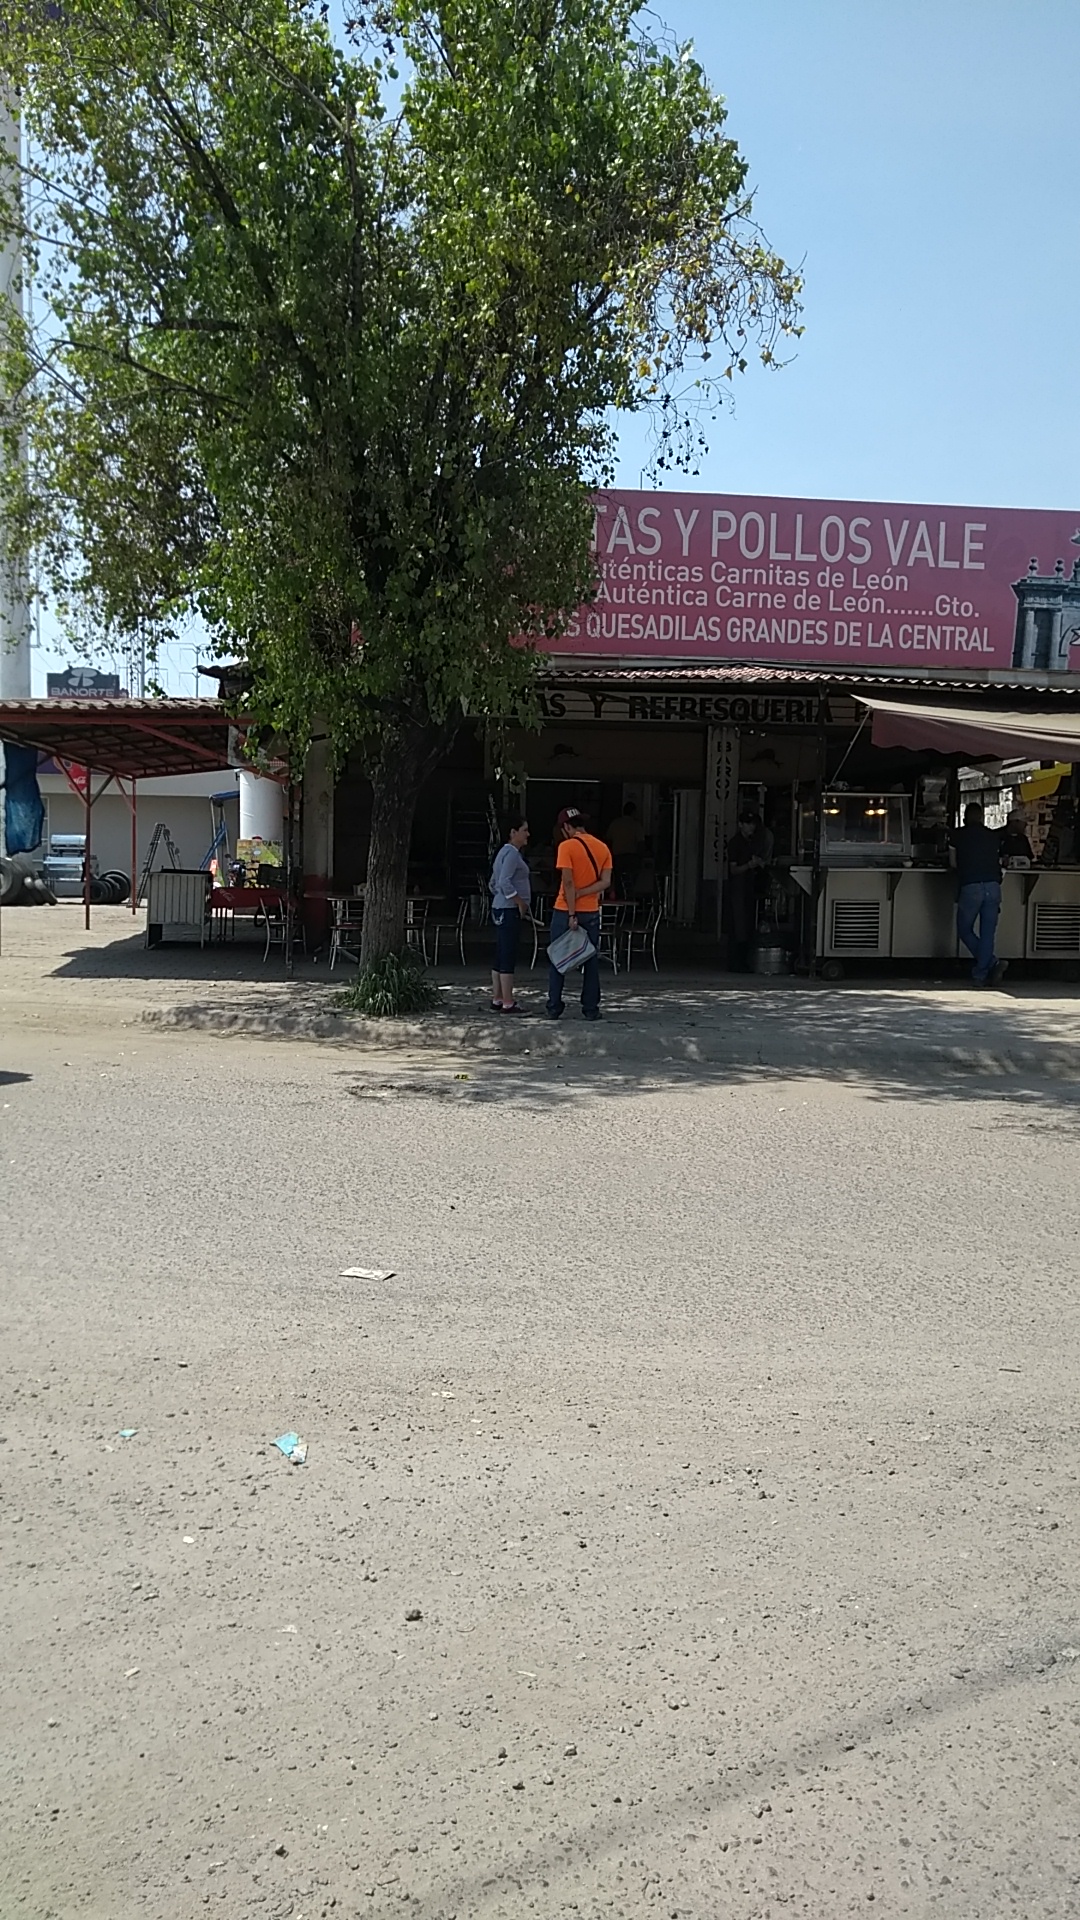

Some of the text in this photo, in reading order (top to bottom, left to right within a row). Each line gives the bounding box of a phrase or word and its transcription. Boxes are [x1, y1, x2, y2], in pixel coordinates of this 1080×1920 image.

[590, 504, 987, 570] TAS Y POLLOS VALE
[597, 557, 909, 592] uténticas Carnitas de León
[594, 580, 708, 607] Auténtica
[715, 585, 786, 610] Carne
[793, 588, 822, 612] de
[586, 612, 721, 642] QUESADILAS
[726, 617, 828, 647] GRANDES
[834, 621, 861, 648] DE
[866, 623, 893, 649] LA
[899, 625, 994, 653] CENTRAL
[50, 687, 115, 697] BANORTE
[588, 693, 606, 719] Y
[628, 695, 834, 723] REFRESQUERIA
